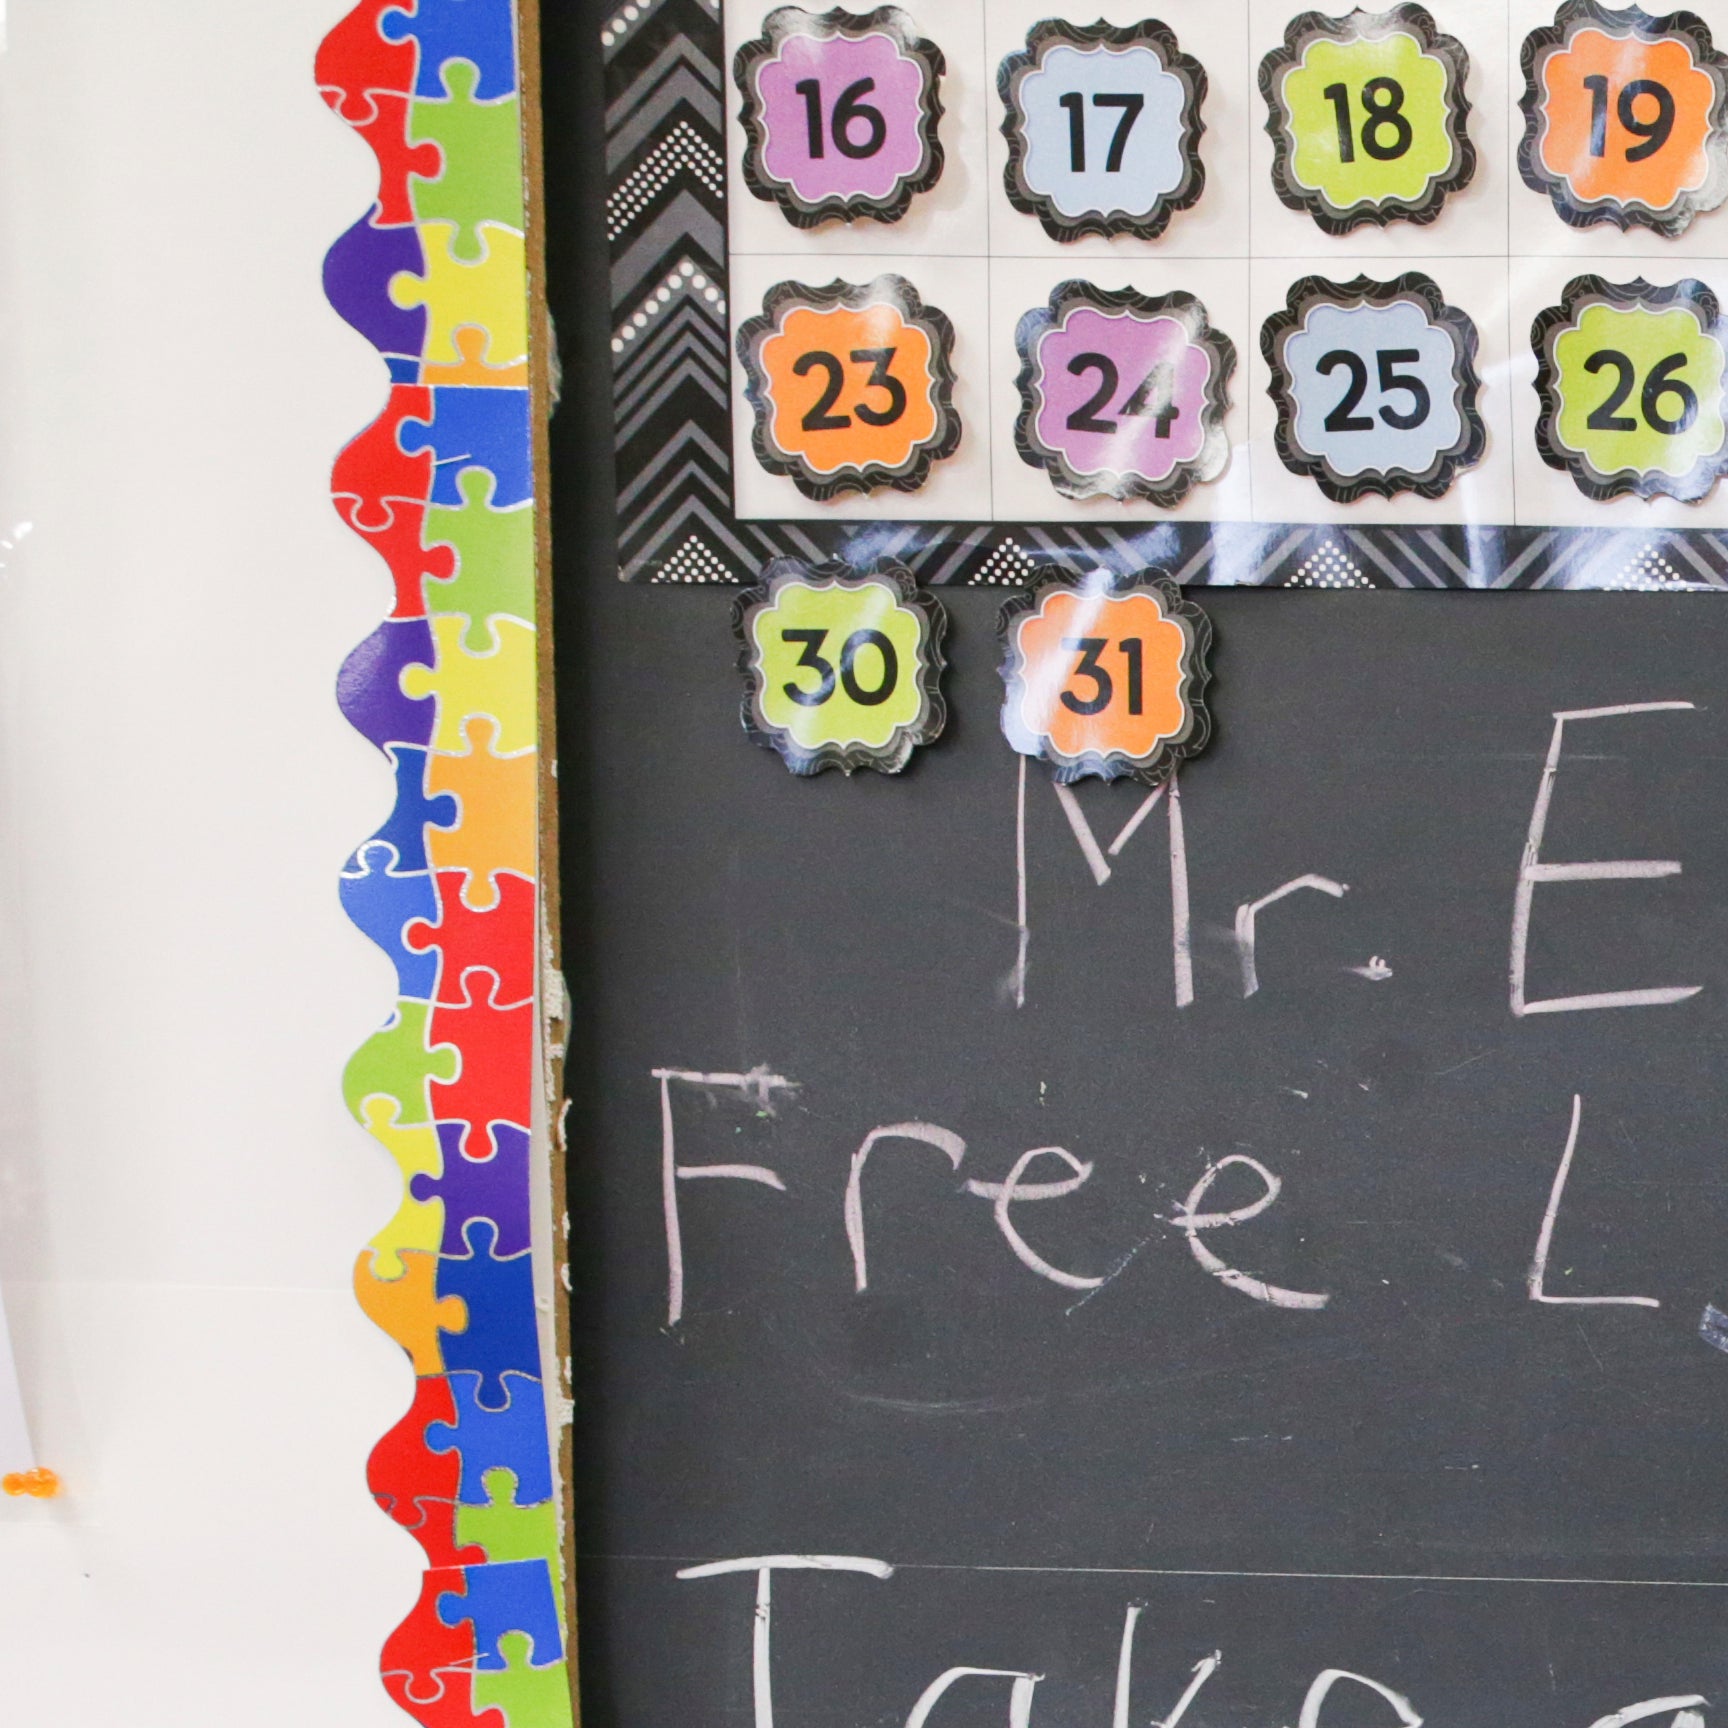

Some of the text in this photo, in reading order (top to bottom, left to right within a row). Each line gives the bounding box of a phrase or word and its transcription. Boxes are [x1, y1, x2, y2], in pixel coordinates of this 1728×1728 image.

[796, 77, 886, 160] 16
[1059, 93, 1145, 173] 17
[1322, 76, 1412, 163] 18
[1583, 74, 1676, 163] 19
[791, 346, 906, 431] 23
[1065, 350, 1180, 439] 24
[1315, 349, 1428, 431] 25
[1583, 350, 1697, 431] 26
[780, 628, 898, 706] 30
[1059, 637, 1143, 716] 31
[1014, 754, 1393, 1008] Mr.
[651, 1066, 1330, 1325] Free
